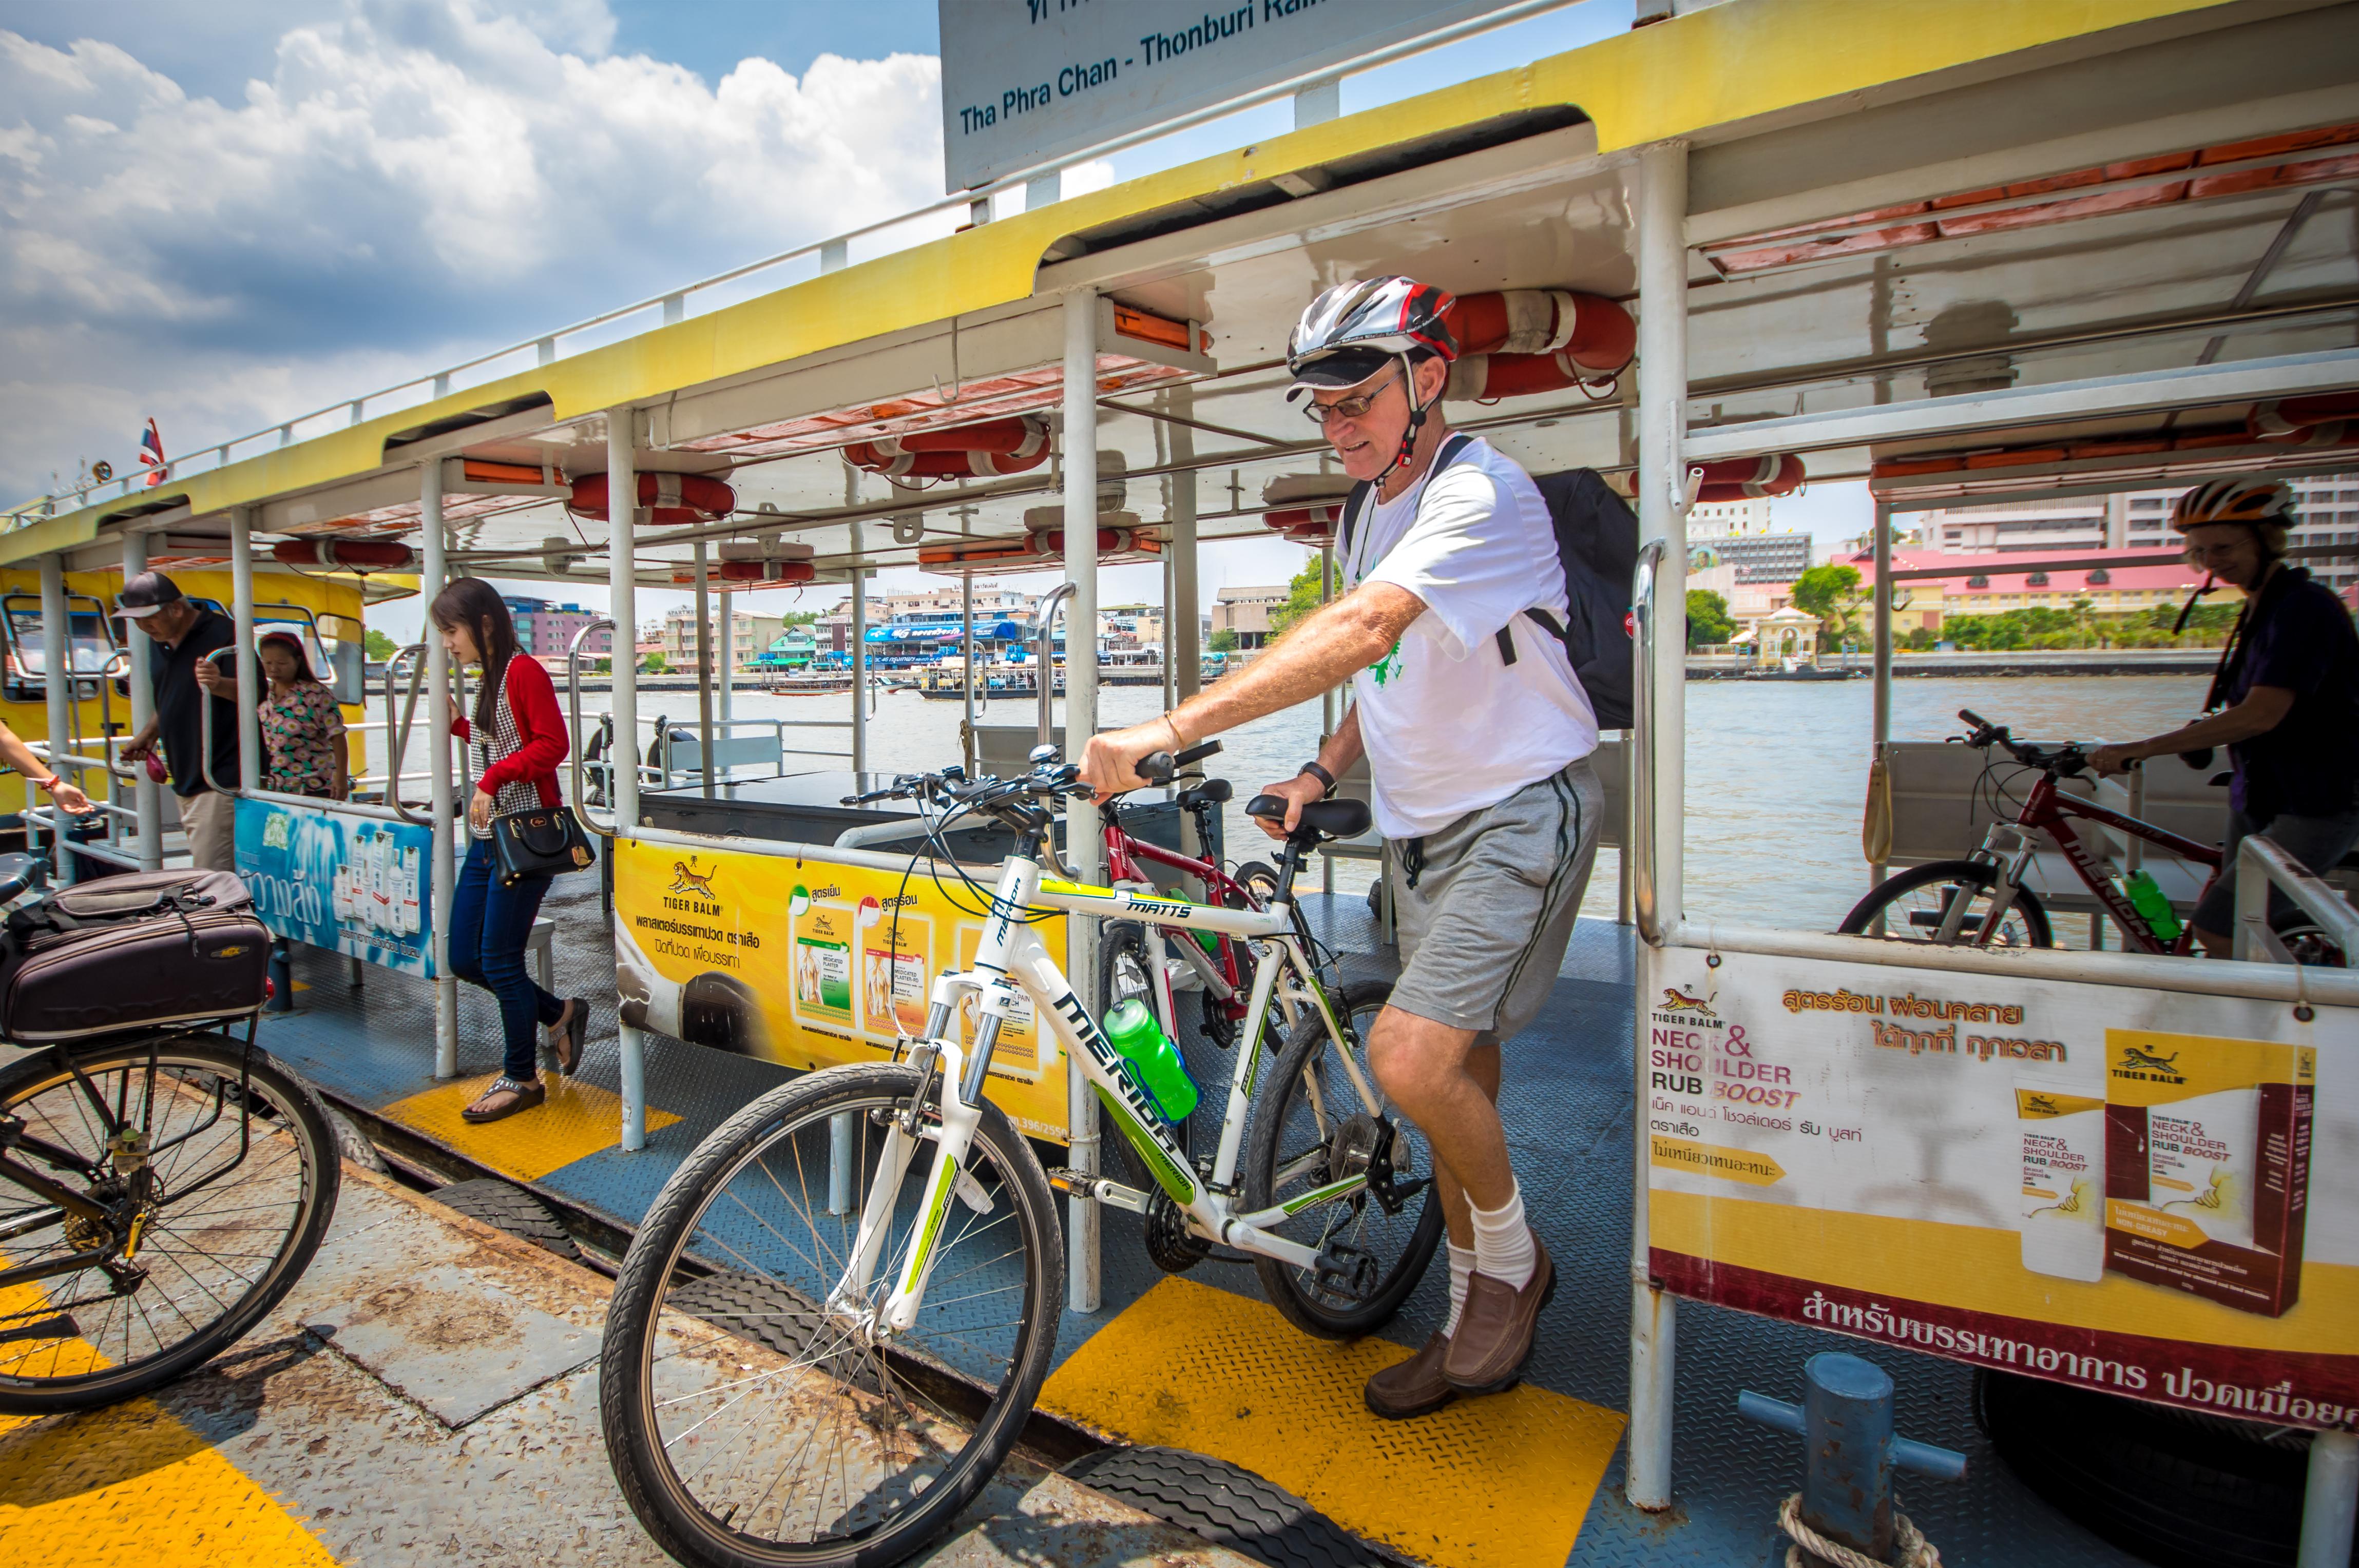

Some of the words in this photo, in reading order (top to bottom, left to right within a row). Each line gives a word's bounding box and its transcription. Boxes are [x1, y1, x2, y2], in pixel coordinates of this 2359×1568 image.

[961, 105, 996, 135] Tha
[1003, 82, 1051, 120] Phra
[1058, 57, 1118, 98] Chan
[1140, 0, 1254, 67] Thonburi
[812, 884, 841, 902] สูตรเย็น
[2063, 839, 2150, 937] MERIDA
[663, 897, 690, 912] TIGER
[1127, 902, 1192, 919] MATTS
[636, 915, 723, 942] พลาสเตอร์บรรเทาปวด
[726, 931, 760, 948] ตราเสือ
[654, 938, 690, 959] ปิดที่ปวด
[693, 944, 740, 969] เพื่อบรรเทา
[823, 956, 843, 964] MEDICATED
[895, 969, 917, 977] MEDICATED
[895, 974, 919, 983] PLASTER-RD
[1782, 989, 1884, 1015] สูตรร้อน
[1889, 993, 2023, 1025] ผ่อนคลาย
[1651, 1013, 1685, 1025] TIGER
[1724, 1024, 1754, 1058] &
[1871, 1020, 1956, 1056] ได้ทุกที่
[1965, 1035, 2066, 1062] ทุกเวลา
[1053, 991, 1178, 1154] MERIDA
[2112, 1069, 2146, 1080] TIGER
[2150, 1072, 2184, 1085] BALM
[1652, 1071, 1703, 1096] RUB
[1710, 1080, 1801, 1110] BOOST
[1650, 1119, 1699, 1137] ตราเสือ
[1652, 1096, 1674, 1112] เน็ค
[1828, 1126, 1862, 1143] บูสท์
[2152, 1120, 2188, 1134] NECK
[2191, 1121, 2206, 1137] &
[701, 1141, 752, 1193] SCHWALBE
[784, 1104, 810, 1121] ROAD
[812, 1091, 850, 1107] CRUISER
[2023, 1137, 2055, 1149] NECK
[2056, 1138, 2068, 1151] &
[2152, 1130, 2227, 1151] SHOULDER
[2152, 1139, 2180, 1152] RUB
[2182, 1146, 2232, 1162] BOOST
[1652, 1139, 1776, 1177] ไม่เหนียวเหนอะหนะ
[2023, 1147, 2085, 1162] SHOULDER
[2023, 1155, 2047, 1166] RUB
[2049, 1159, 2089, 1172] BOOST
[1157, 1153, 1192, 1191] MERIDA
[944, 1169, 961, 1207] MERIDA
[2116, 1217, 2168, 1237] NON-GREASY
[1802, 1291, 2147, 1389] สำหรับบรรเทาอาการ
